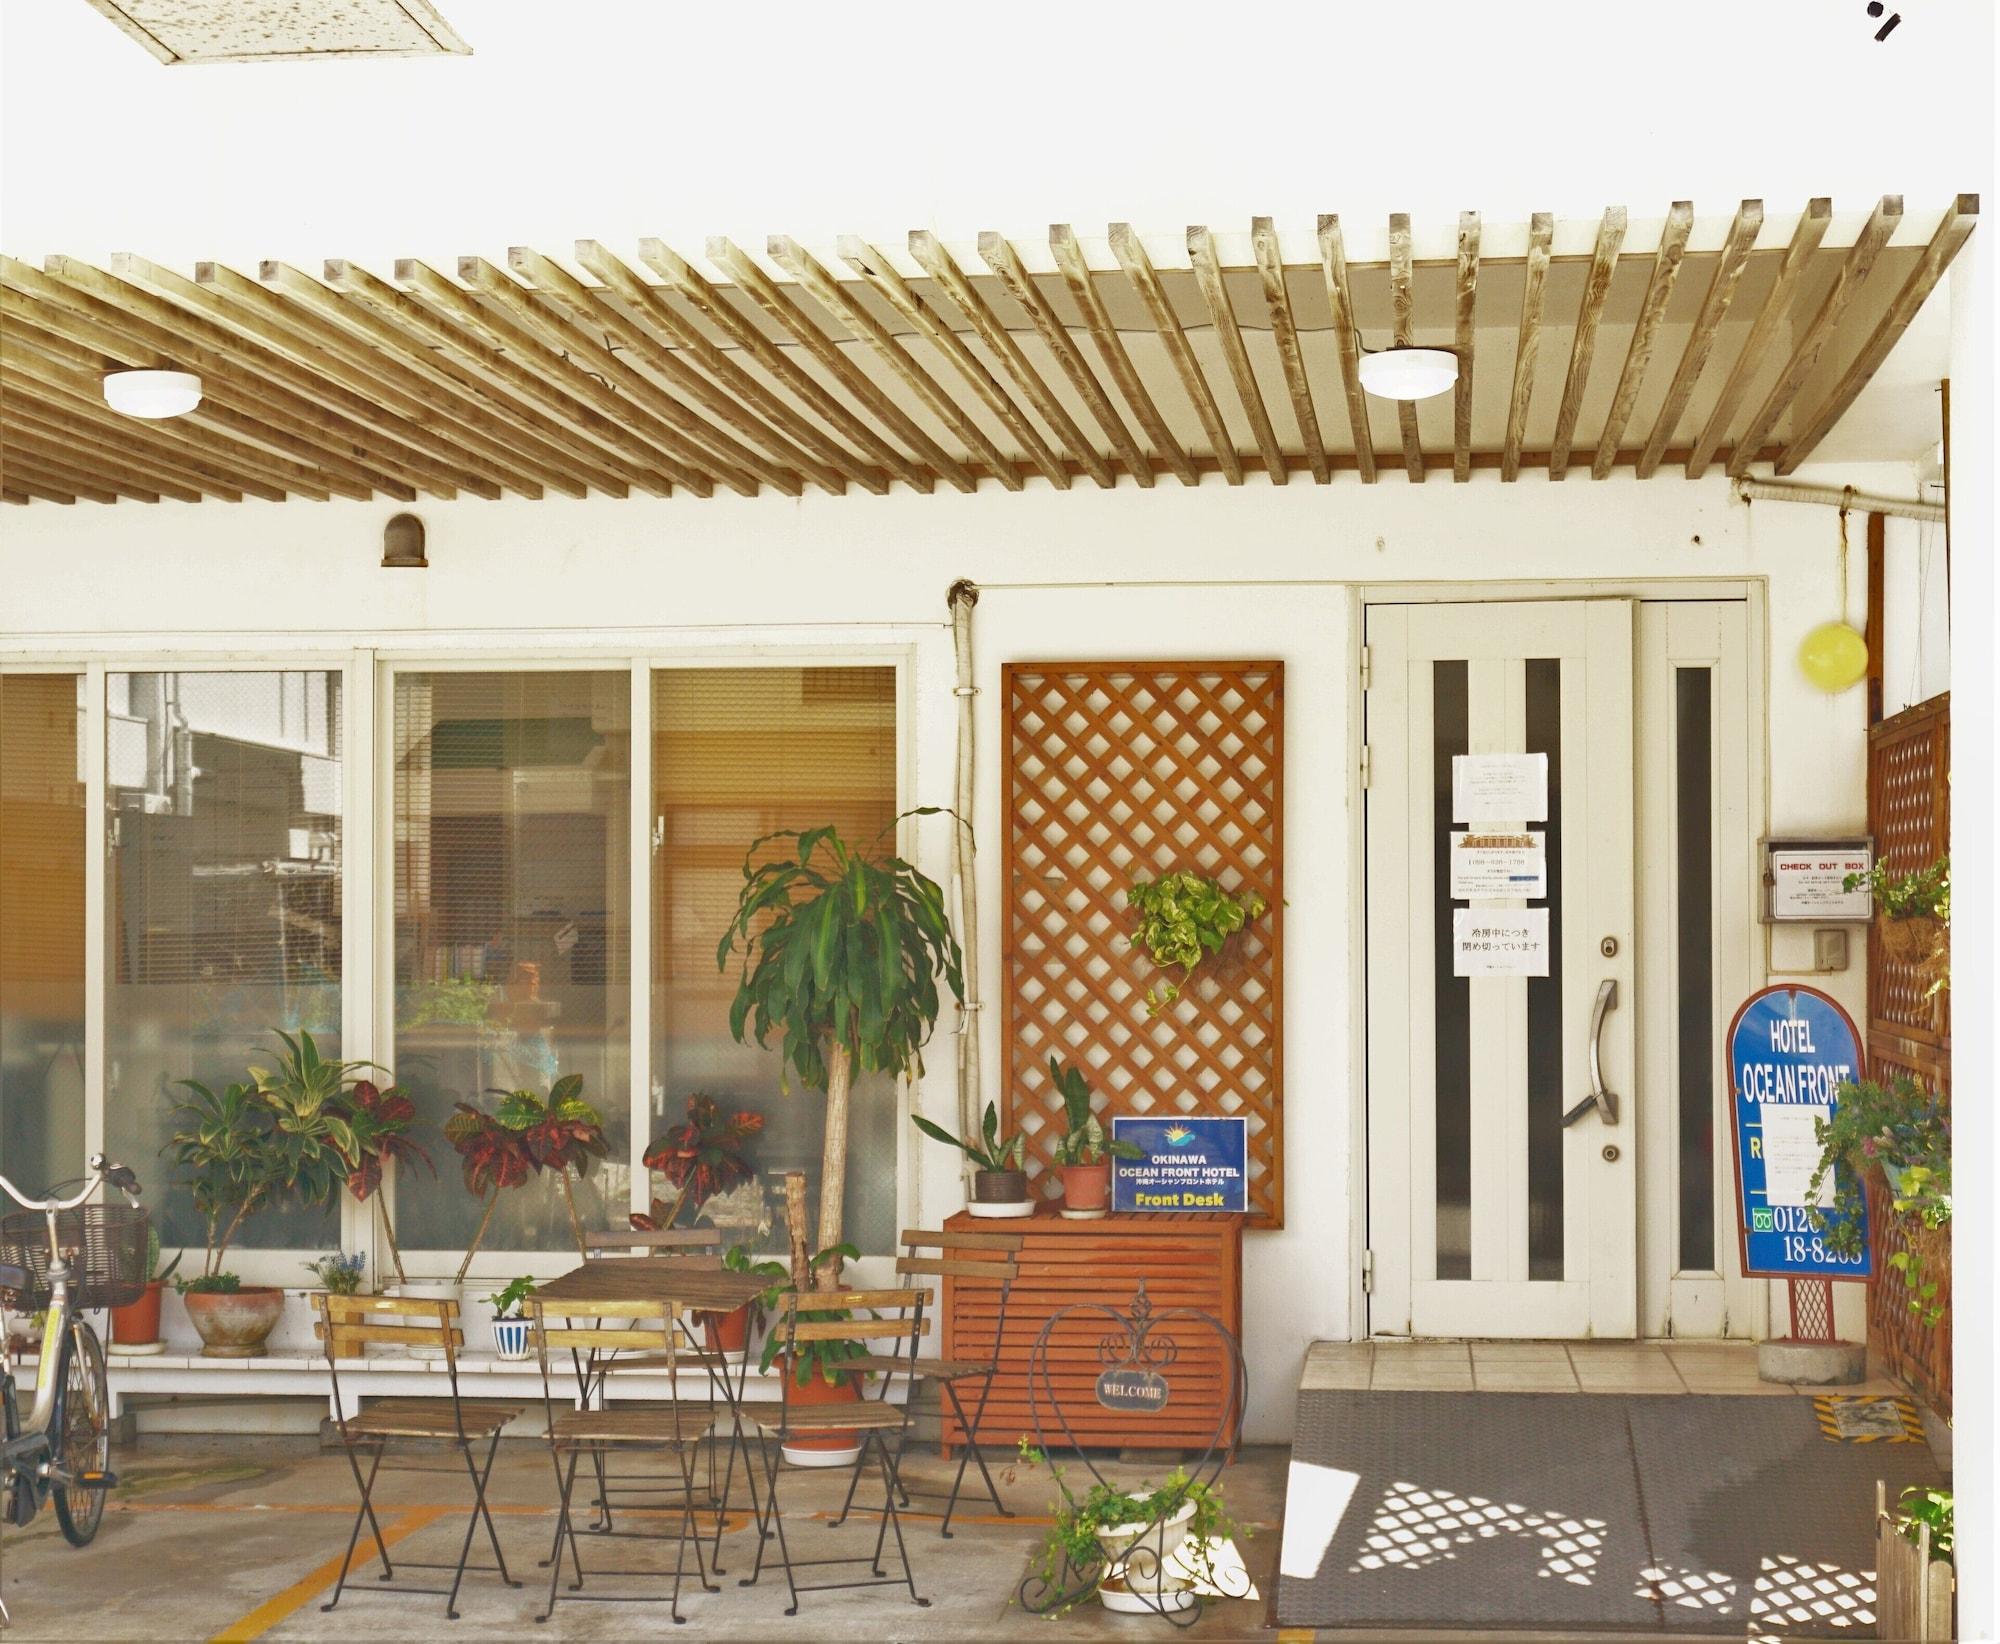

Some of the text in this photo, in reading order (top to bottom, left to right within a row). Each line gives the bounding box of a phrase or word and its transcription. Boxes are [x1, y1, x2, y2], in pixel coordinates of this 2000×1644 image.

[1780, 863, 1812, 871] CHECK
[1844, 862, 1865, 870] BOX
[1471, 927, 1529, 938] 冷房中につき
[1462, 942, 1541, 952] 閉め切っています
[1770, 1019, 1816, 1053] HOTEL
[1742, 1063, 1850, 1105] OCEAN FRONT
[1151, 1155, 1207, 1165] OKINAWA
[1119, 1167, 1240, 1178] OCEAN FRONT HOTEL
[1135, 1193, 1225, 1206] Front Desk
[1104, 1383, 1162, 1399] WELCOME
